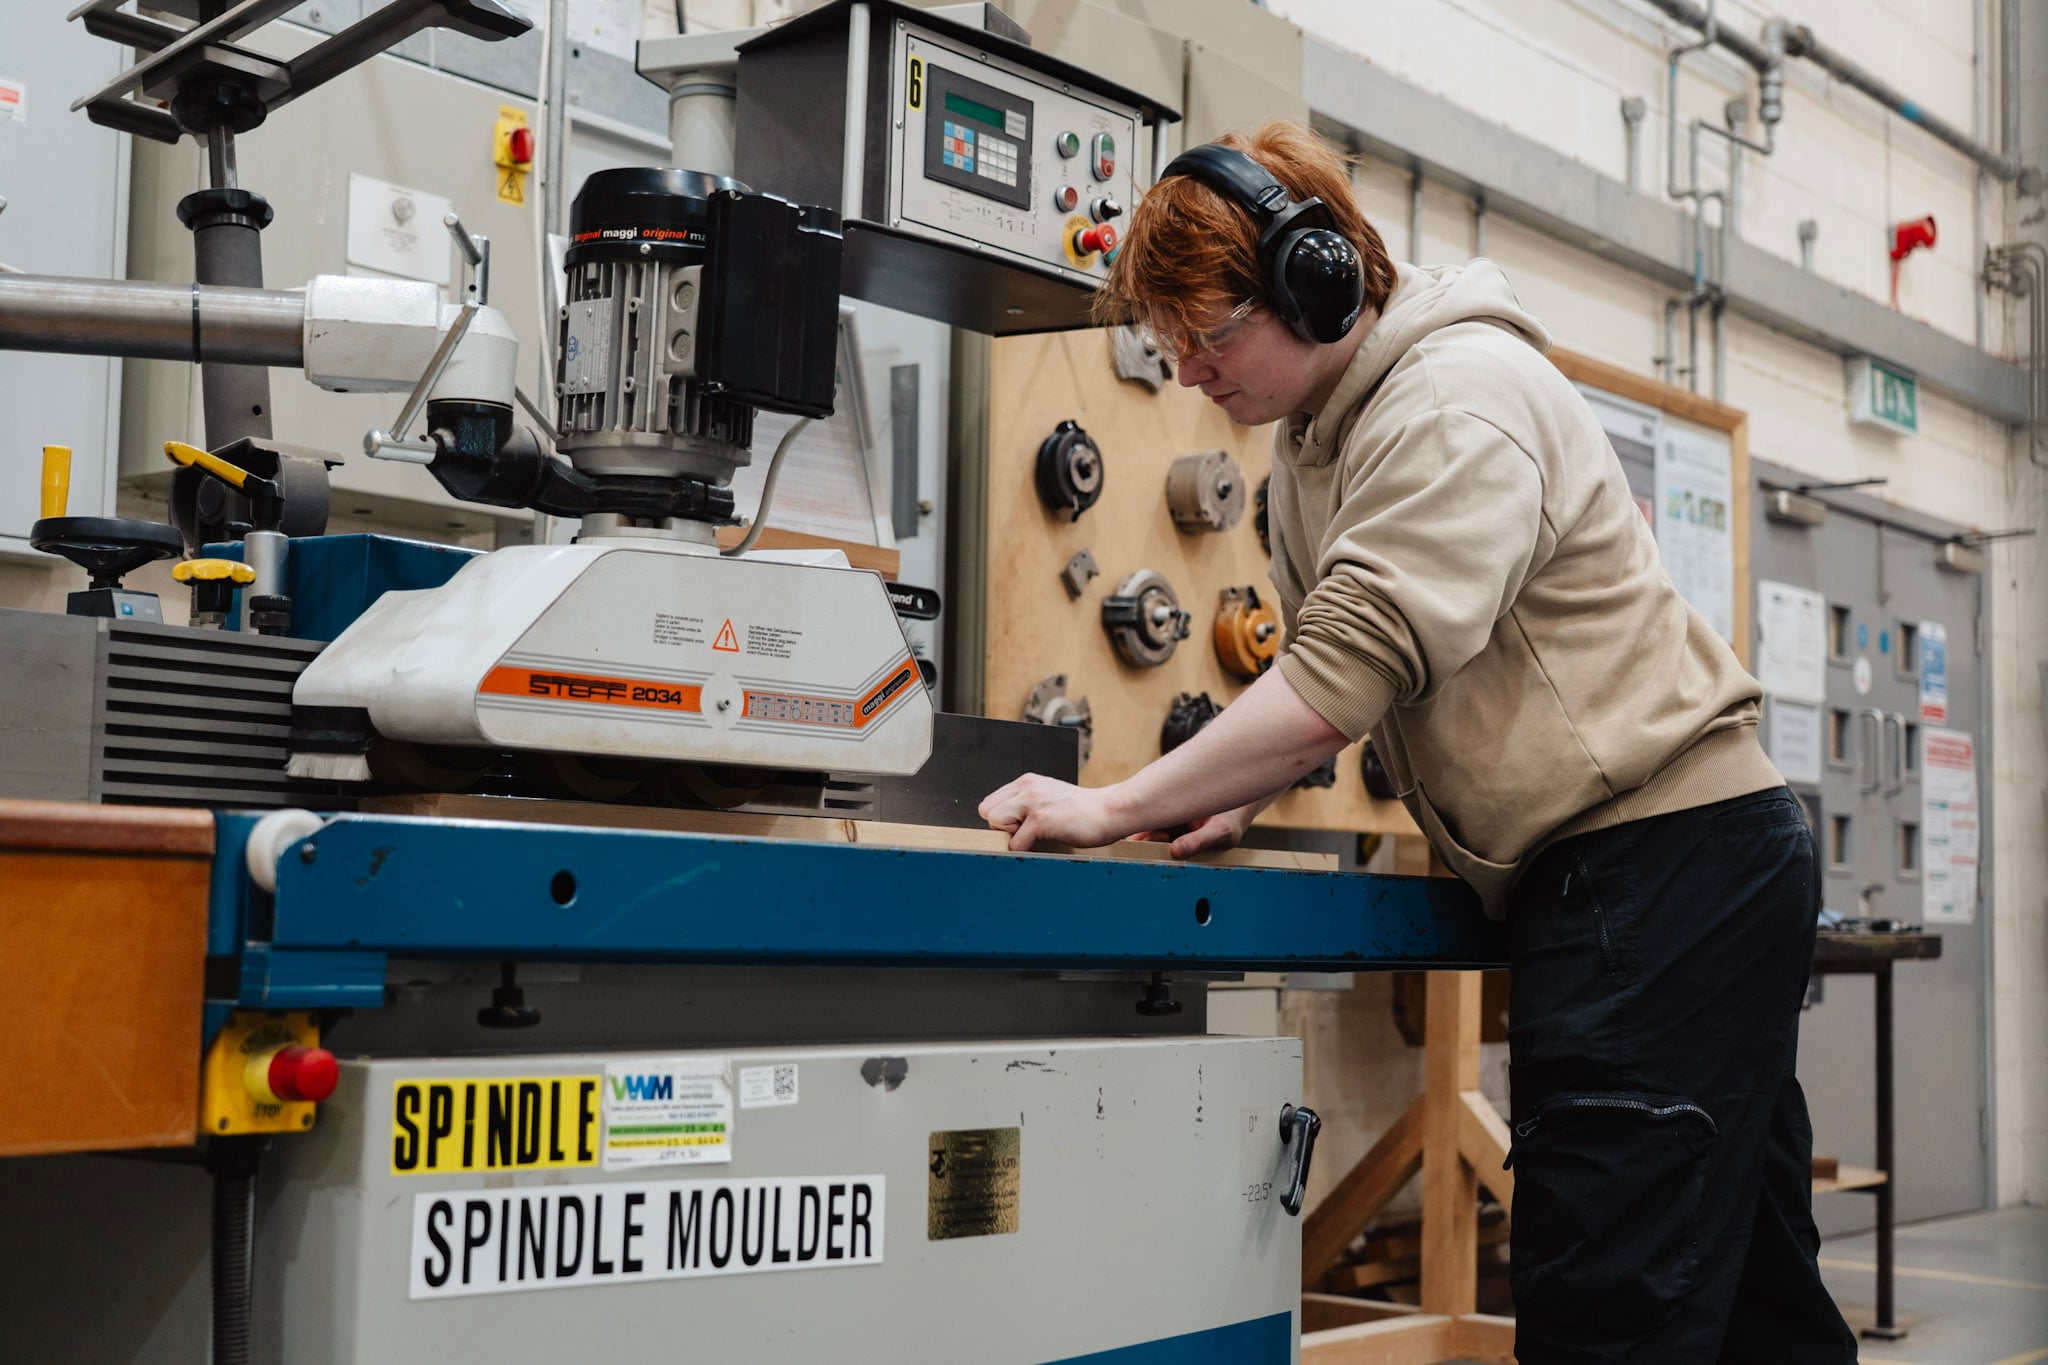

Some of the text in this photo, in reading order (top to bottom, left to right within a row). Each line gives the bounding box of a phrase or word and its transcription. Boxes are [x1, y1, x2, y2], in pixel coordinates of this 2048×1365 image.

[910, 59, 921, 108] 6
[574, 229, 601, 243] original
[602, 226, 638, 240] maggi
[642, 227, 687, 240] original
[889, 593, 914, 605] rend
[529, 674, 682, 705] STEFF 2034
[863, 690, 886, 715] maggi
[395, 1082, 594, 1170] SPINDLE
[1241, 1182, 1272, 1202] -22.5°
[425, 1193, 644, 1287] SPINDLE
[668, 1184, 871, 1269] MOULDER
